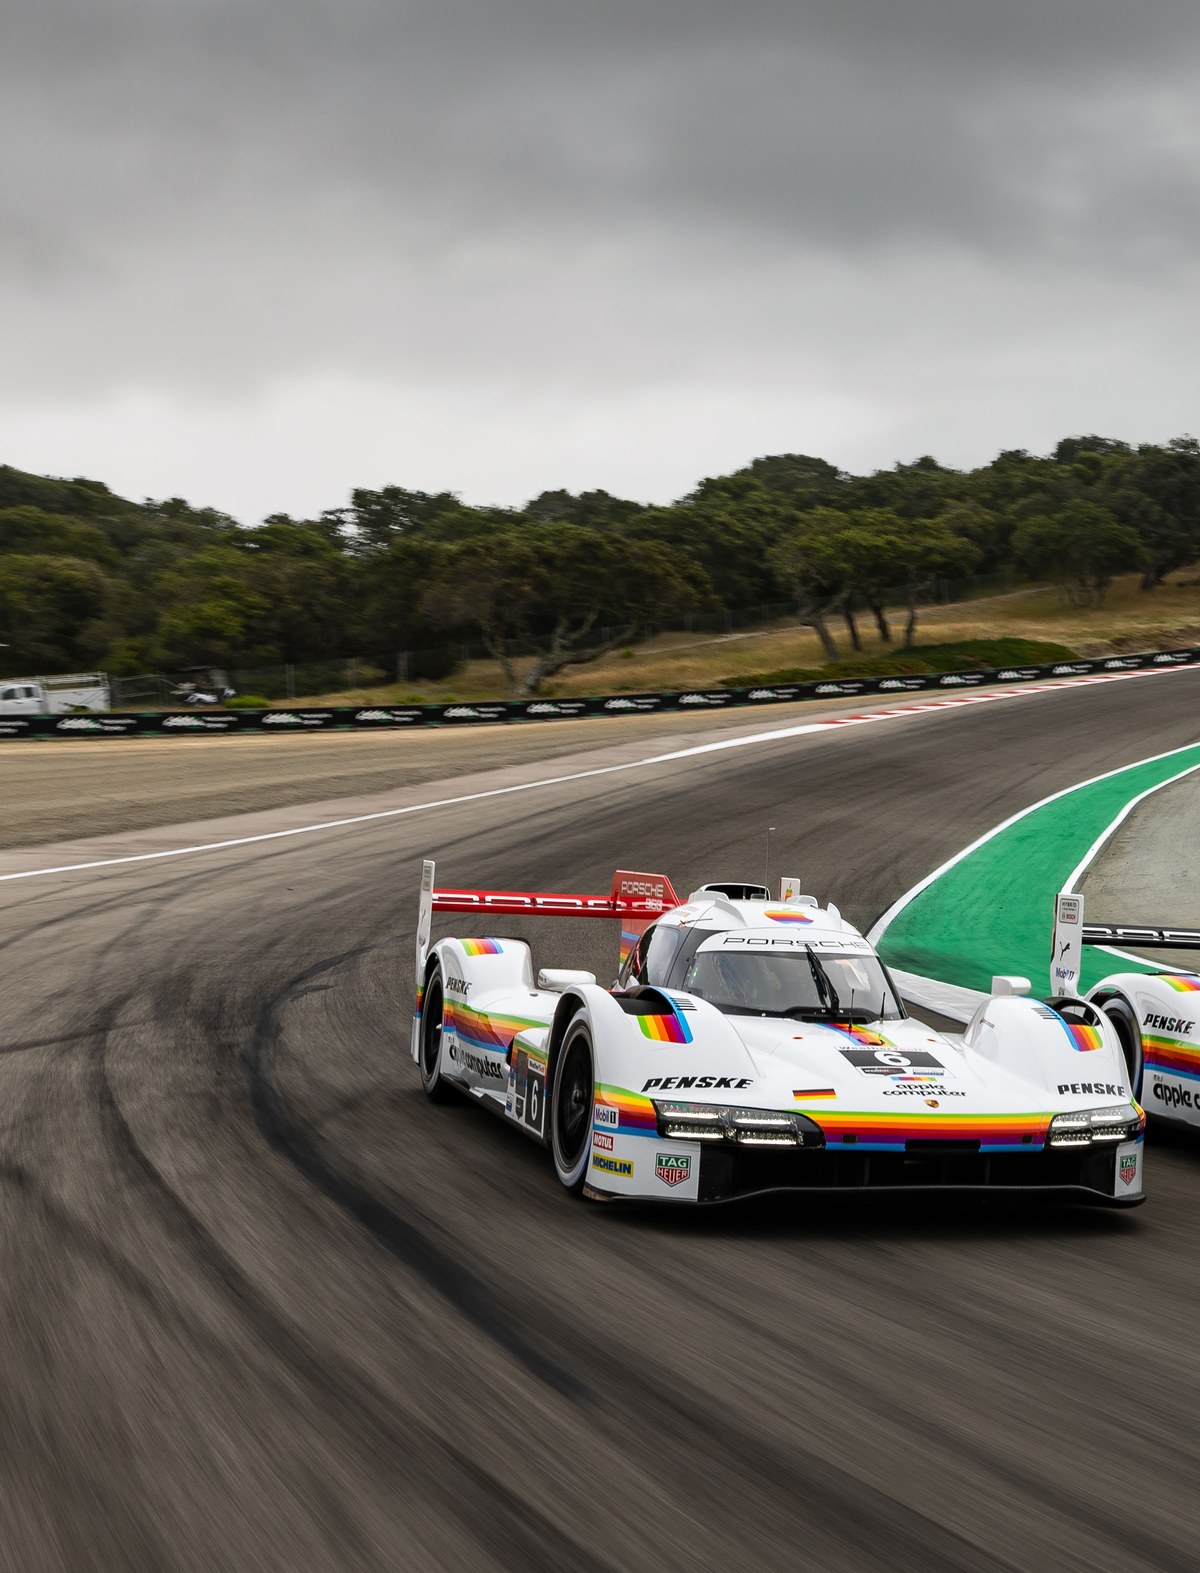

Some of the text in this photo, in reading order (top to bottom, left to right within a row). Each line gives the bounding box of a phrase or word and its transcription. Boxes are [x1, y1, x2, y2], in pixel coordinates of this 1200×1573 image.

[621, 881, 663, 897] PORSCHE
[723, 937, 870, 950] PORSCHE
[446, 976, 473, 996] PENSKE
[1143, 1013, 1195, 1035] PENSKE
[874, 1050, 911, 1067] 6
[641, 1076, 754, 1092] PENSKE
[896, 1083, 945, 1091] apple
[1057, 1083, 1126, 1098] PENSKE
[531, 1079, 538, 1121] 6
[882, 1089, 966, 1098] computer
[1153, 1083, 1191, 1109] apple
[594, 1134, 612, 1149] MOTUL
[593, 1155, 632, 1175] MICHELIN
[660, 1156, 688, 1167] TAG
[1122, 1158, 1136, 1168] TAG
[657, 1167, 689, 1187] HEUER
